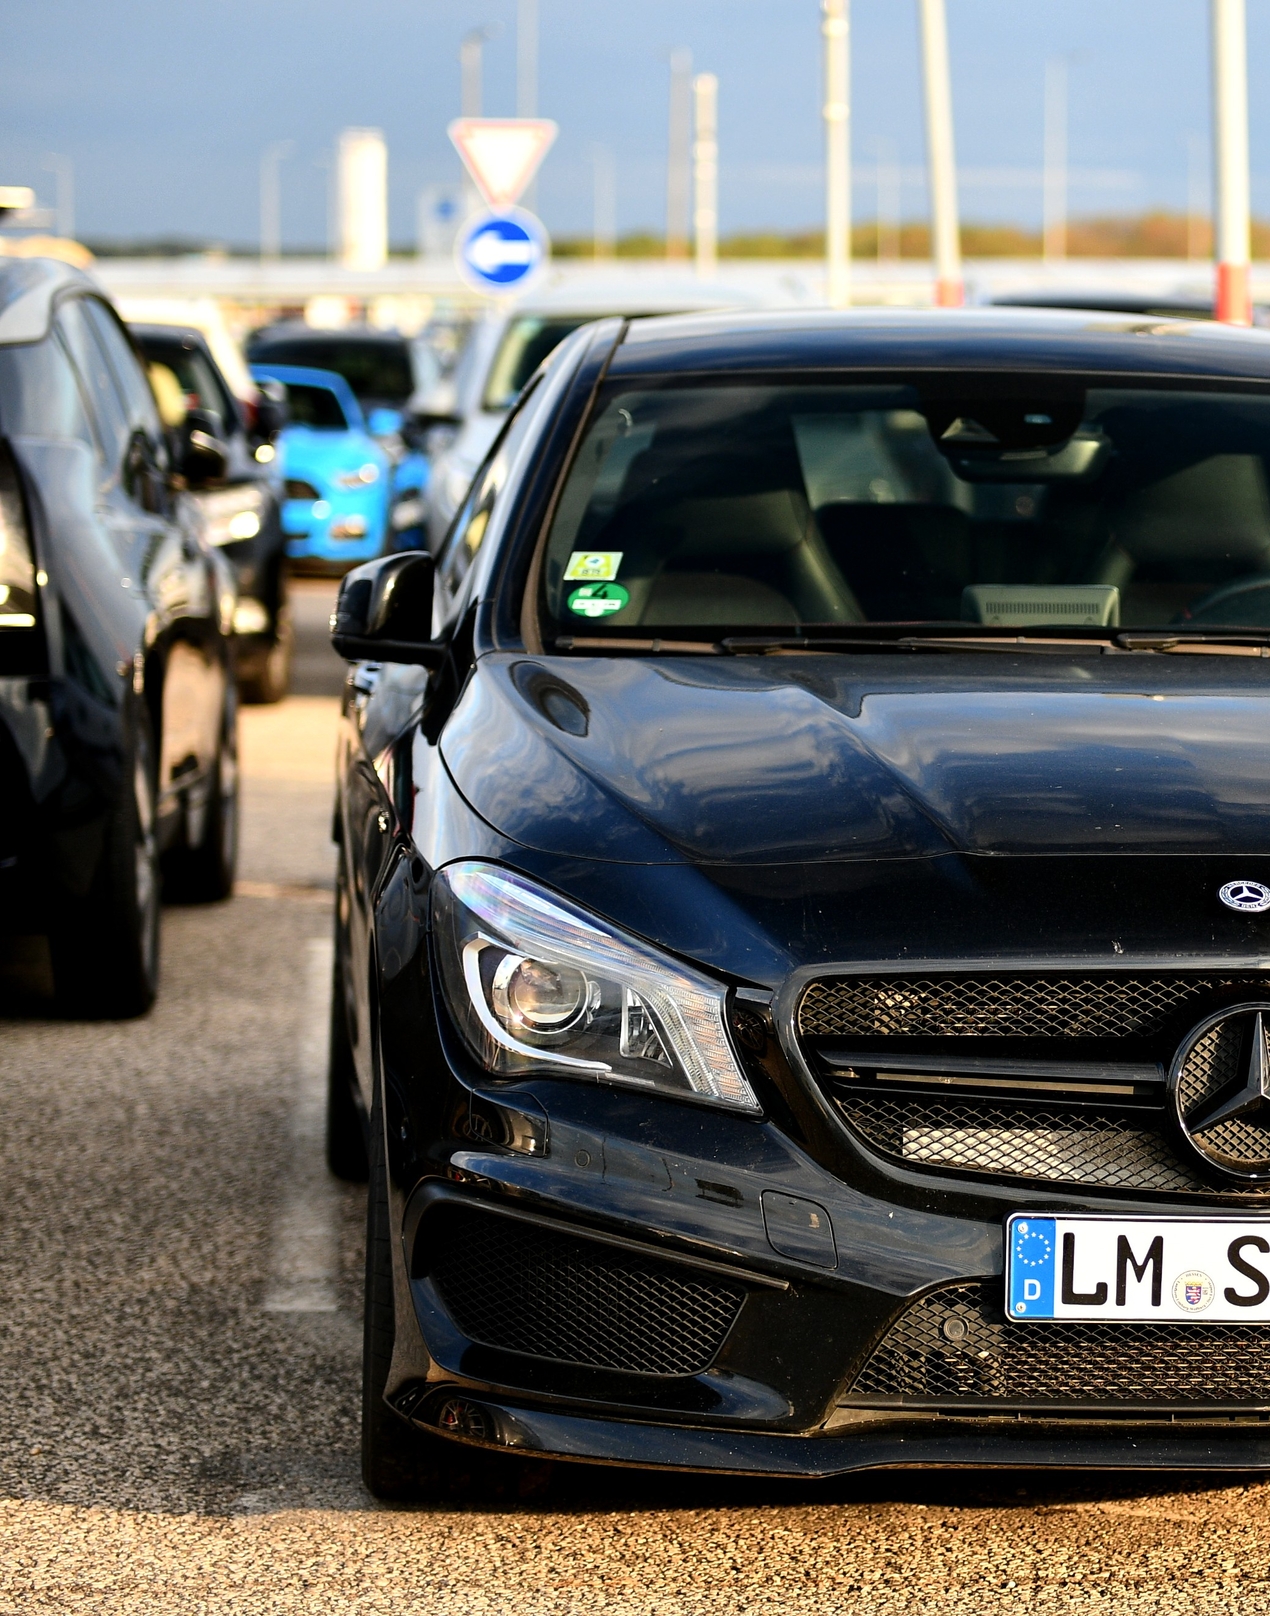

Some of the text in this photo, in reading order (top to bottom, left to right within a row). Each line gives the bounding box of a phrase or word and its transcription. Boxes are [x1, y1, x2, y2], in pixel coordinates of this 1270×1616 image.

[591, 582, 609, 600] 4
[1061, 1232, 1164, 1307] LM
[1023, 1279, 1041, 1300] D
